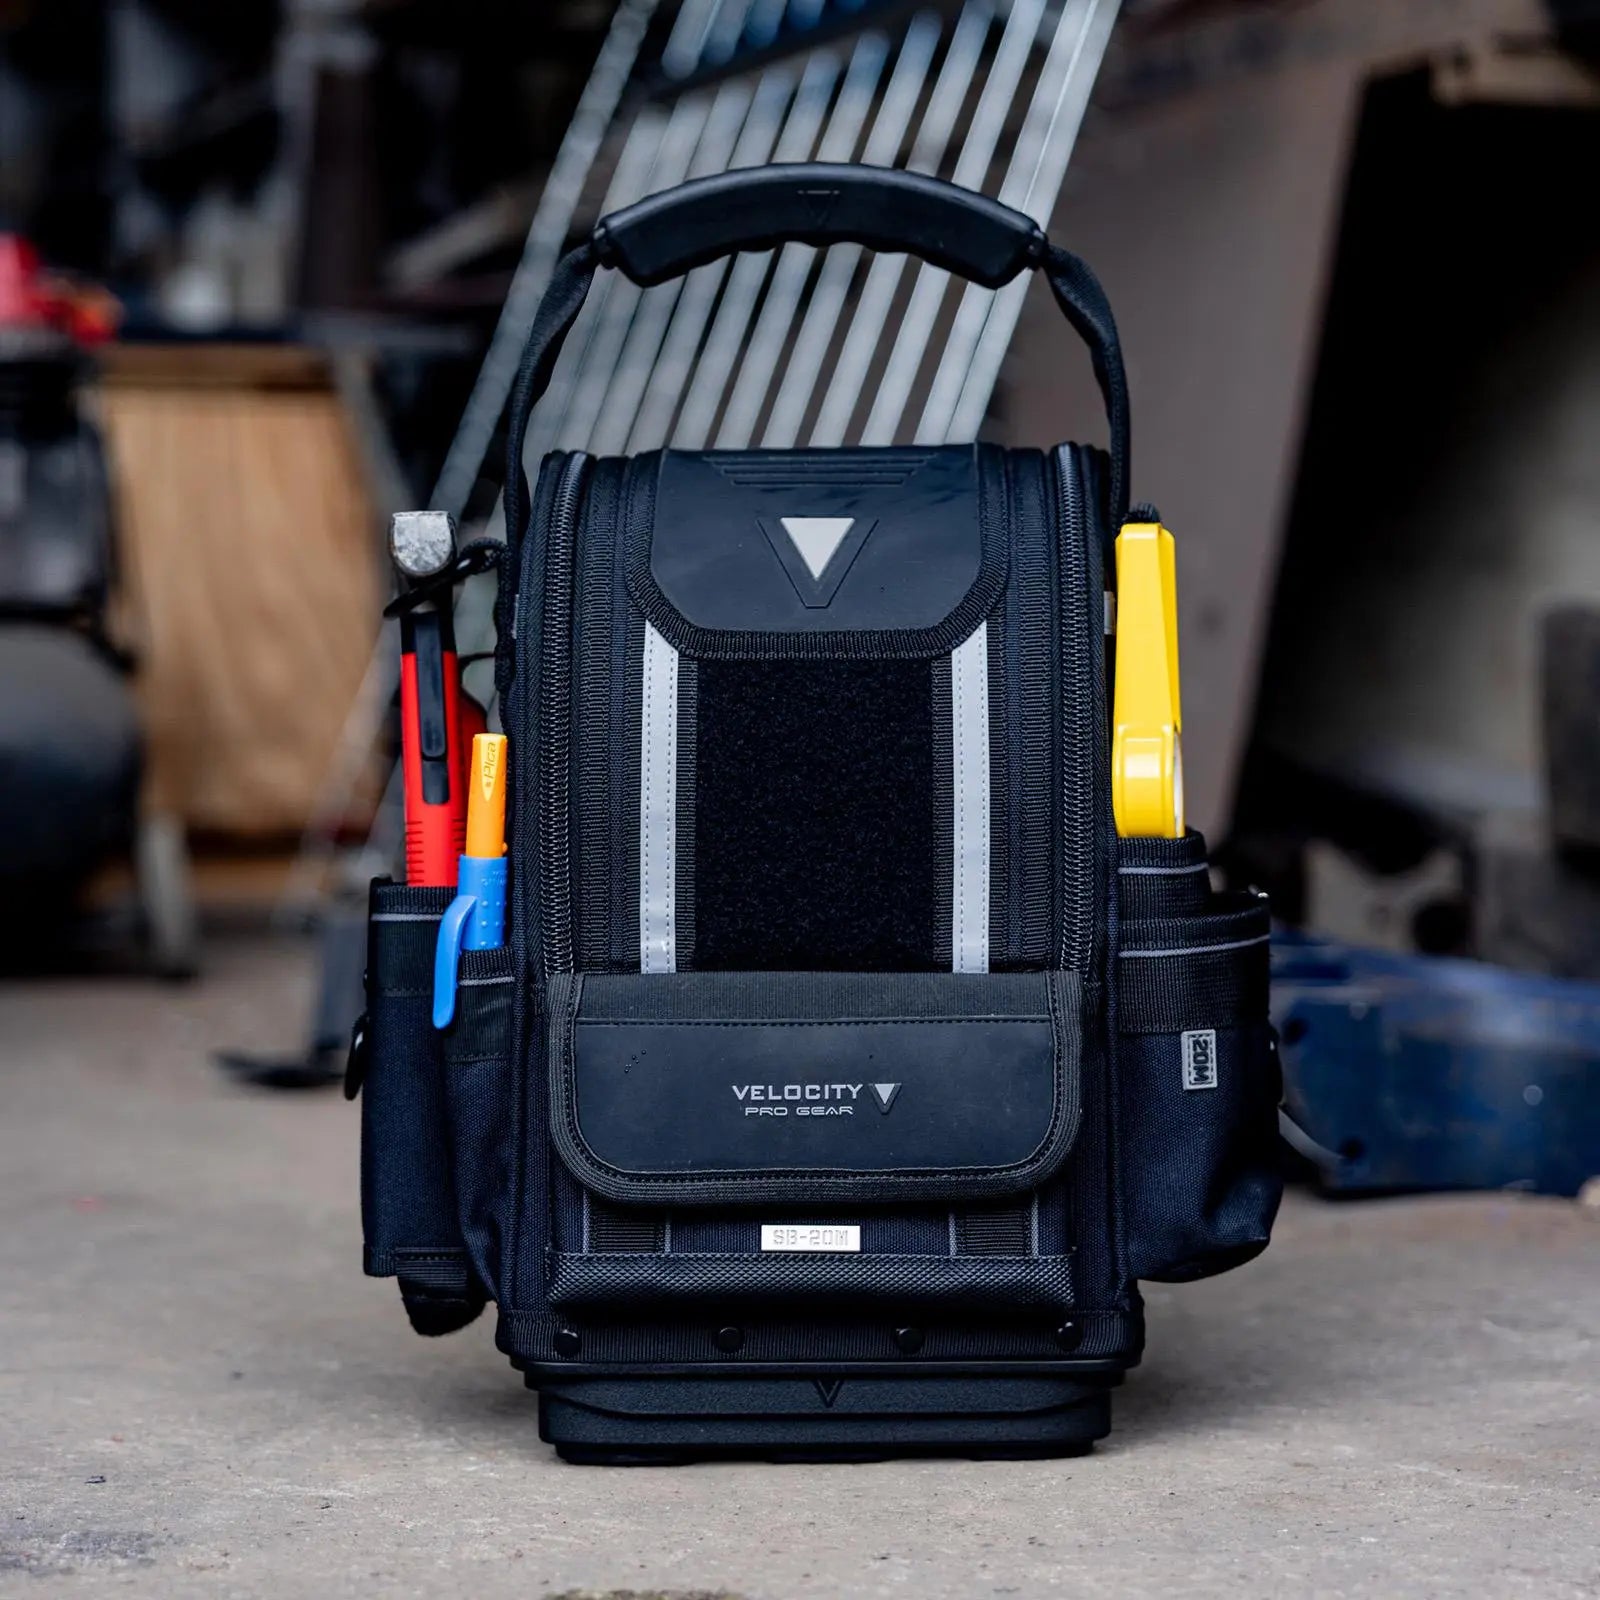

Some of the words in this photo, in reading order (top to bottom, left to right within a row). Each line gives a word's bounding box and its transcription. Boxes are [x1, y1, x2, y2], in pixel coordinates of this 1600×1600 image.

[1192, 1038, 1210, 1082] 20M
[732, 1084, 863, 1100] VELOCITY
[745, 1106, 788, 1116] PRO
[796, 1106, 853, 1116] GEAR
[773, 1229, 848, 1246] SB-20M
